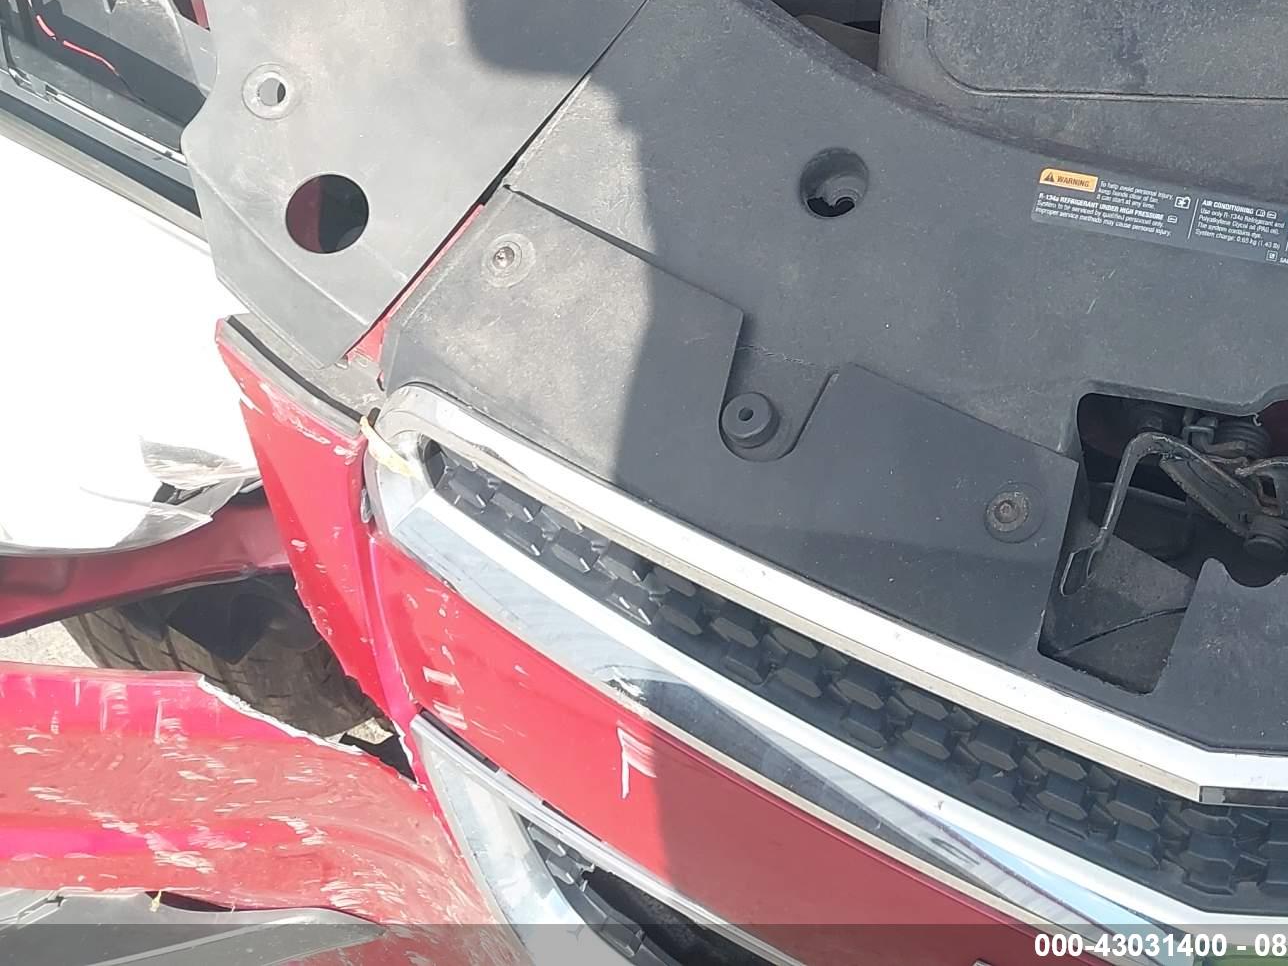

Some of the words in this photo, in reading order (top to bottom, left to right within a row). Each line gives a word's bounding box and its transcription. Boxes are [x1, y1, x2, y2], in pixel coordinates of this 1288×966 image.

[1057, 175, 1090, 187] WARNING
[1099, 204, 1119, 212] UNDER
[1120, 207, 1134, 215] HIGH
[1134, 210, 1165, 220] PRESSURE
[1212, 210, 1223, 218] only
[1213, 202, 1254, 214] CONDITIONING
